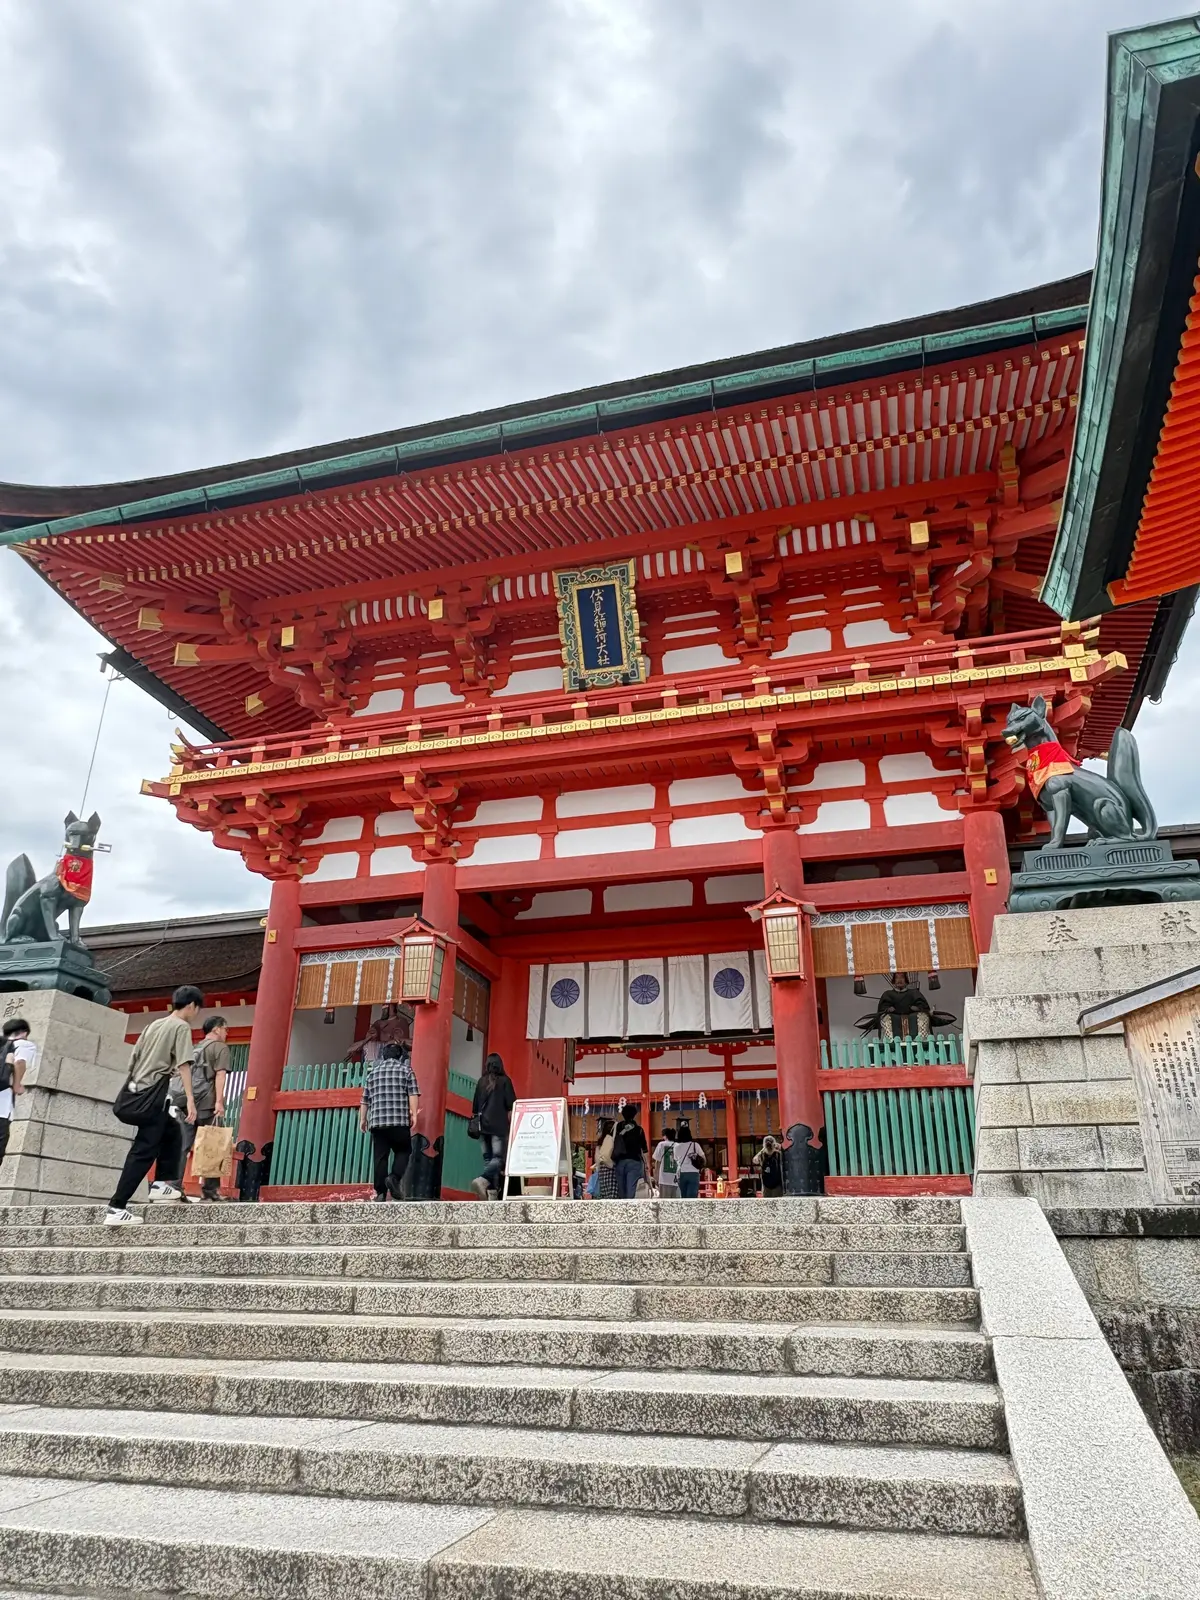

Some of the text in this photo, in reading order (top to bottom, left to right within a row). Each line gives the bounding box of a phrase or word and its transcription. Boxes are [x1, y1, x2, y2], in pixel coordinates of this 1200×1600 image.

[590, 589, 610, 666] 伏見稲荷大社
